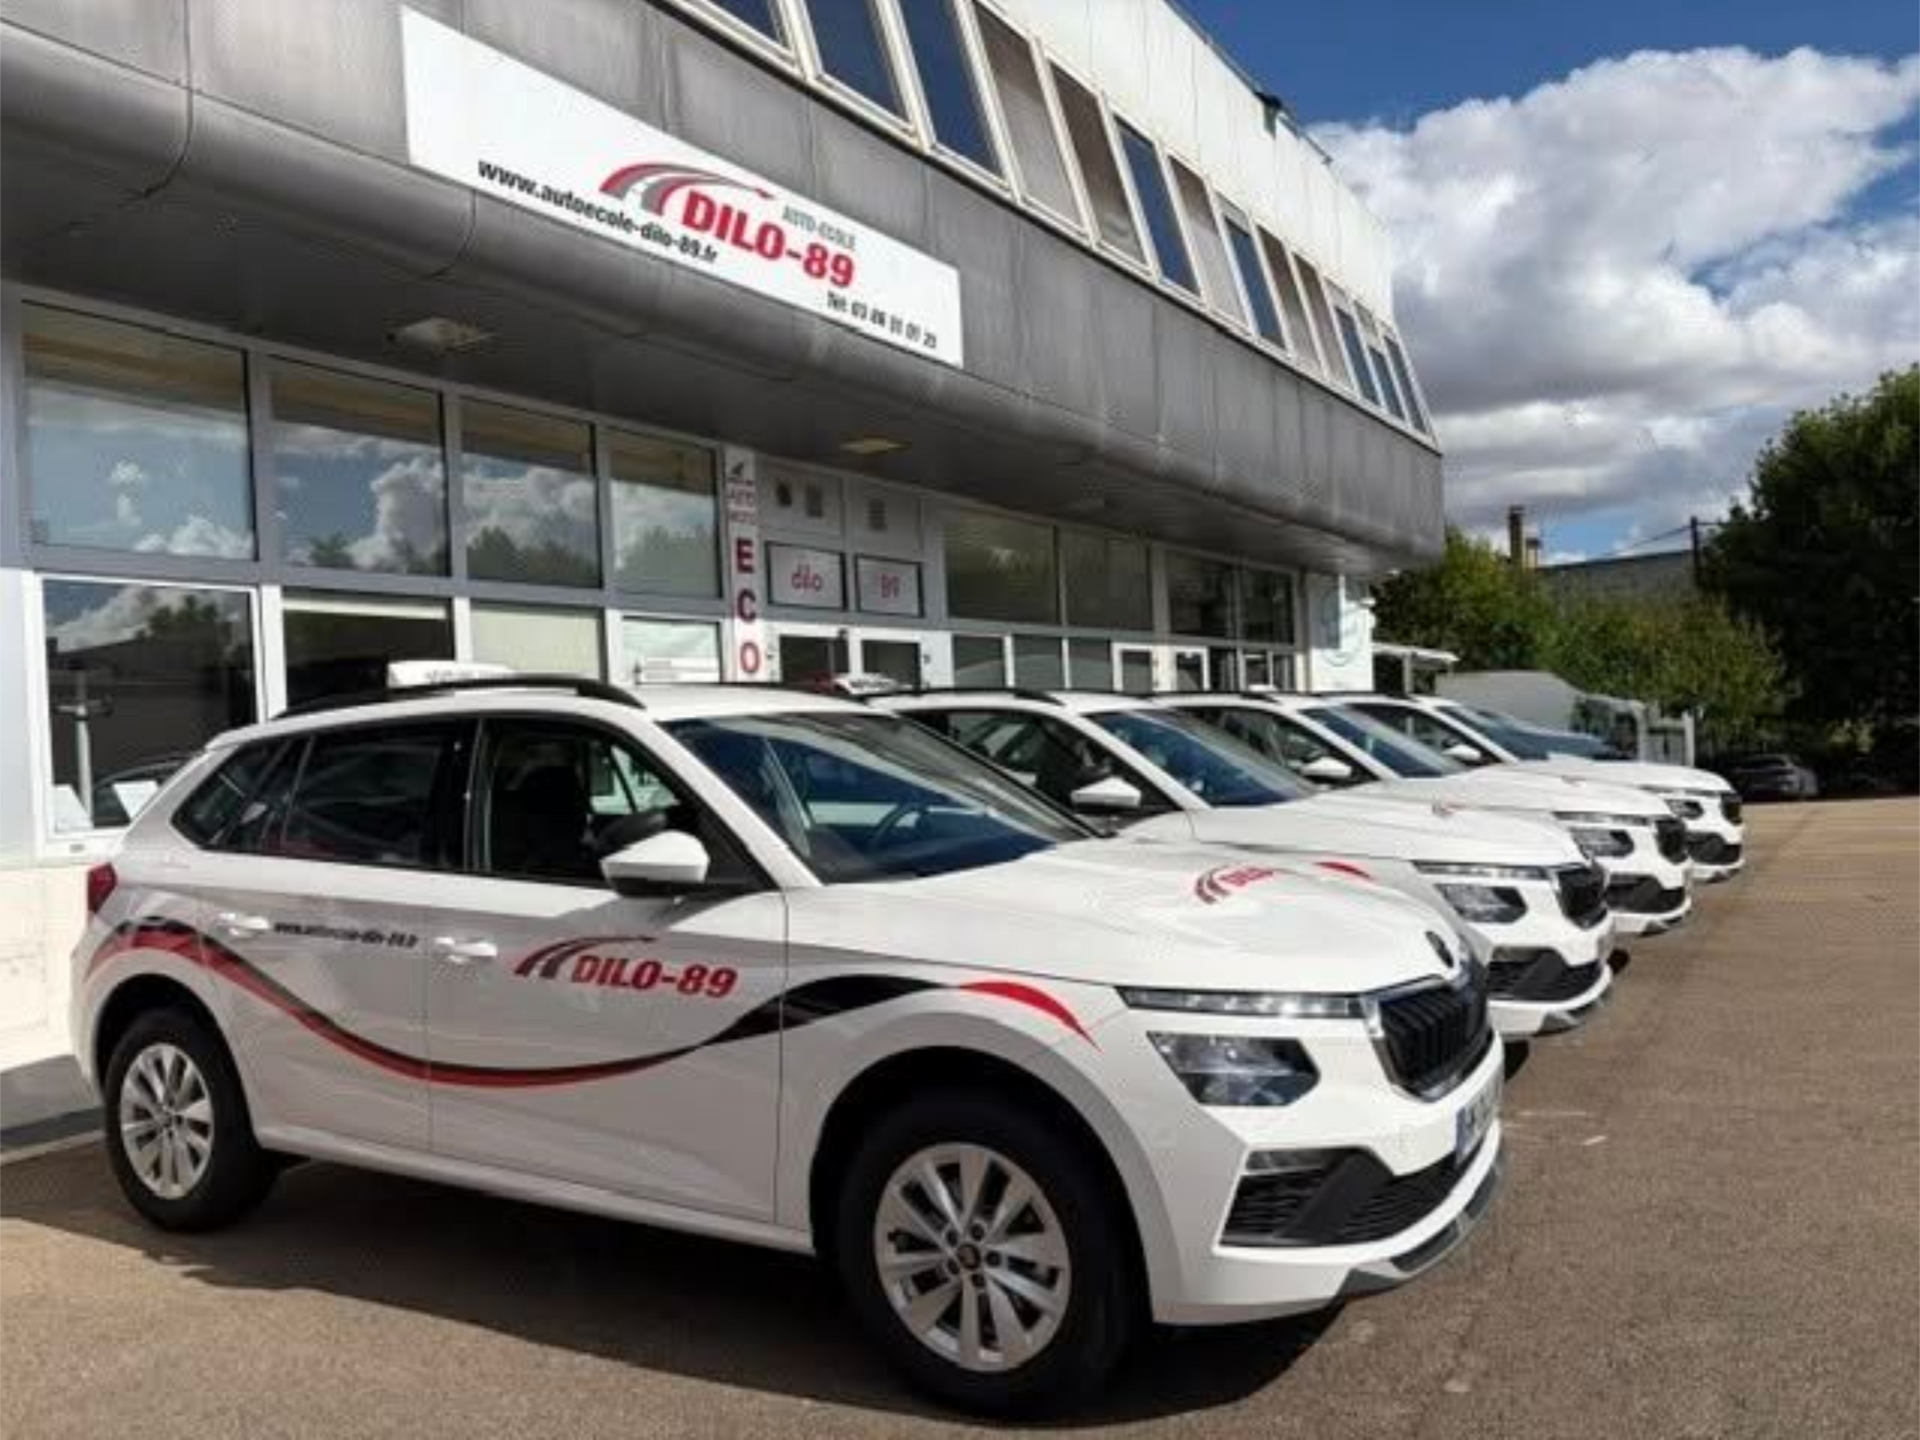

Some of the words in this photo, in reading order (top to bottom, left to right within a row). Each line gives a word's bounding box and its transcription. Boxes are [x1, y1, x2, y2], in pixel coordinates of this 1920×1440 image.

[478, 160, 718, 263] www.autoecole-dilo-89.fr
[682, 189, 854, 287] DILO-89
[571, 954, 739, 998] DILO-89
